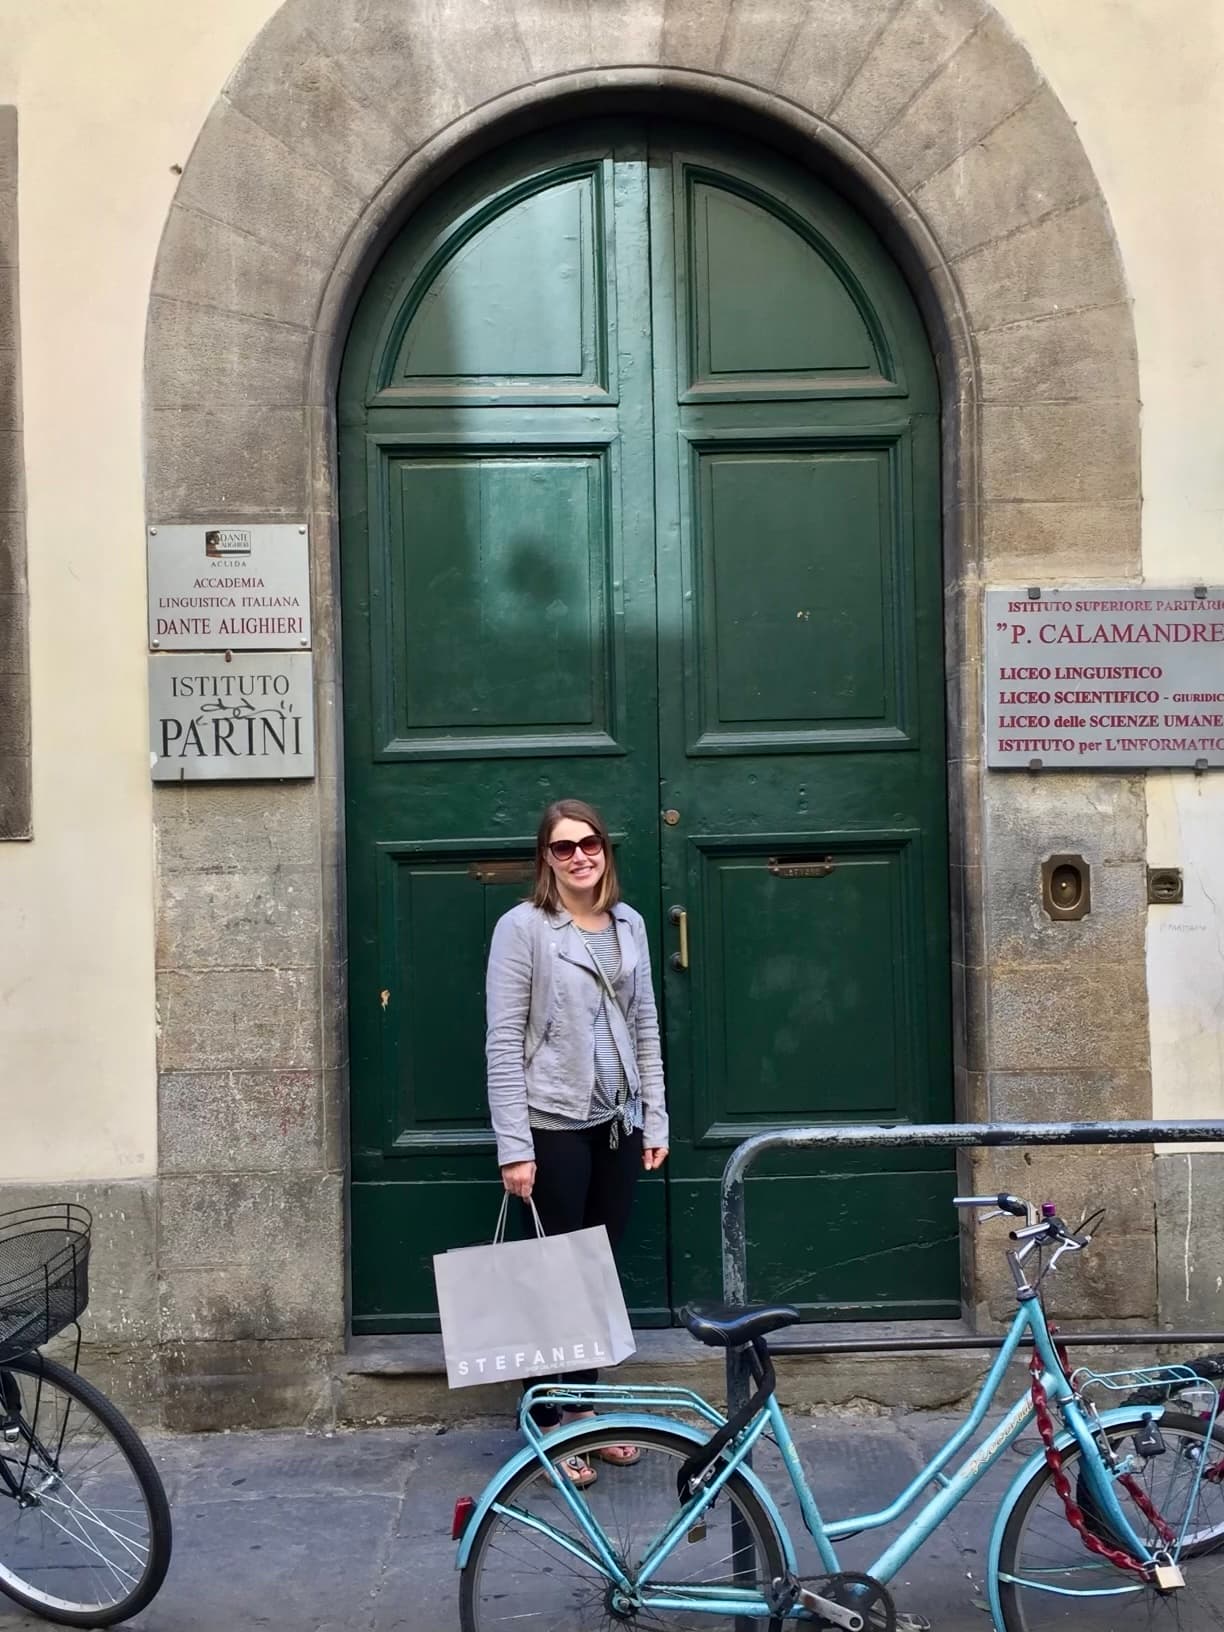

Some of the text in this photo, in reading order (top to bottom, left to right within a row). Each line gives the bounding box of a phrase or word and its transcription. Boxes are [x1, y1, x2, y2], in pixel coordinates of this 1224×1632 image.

[193, 578, 264, 588] ACCADEMIA
[159, 596, 300, 608] LINGUISTICA ITALIANA
[1008, 601, 1072, 612] ISTITUTO
[1075, 601, 1152, 612] SUPERIORE
[157, 617, 303, 635] DANTE ALIGHIERI
[1000, 666, 1162, 680] LICEO LINGUISTICO
[171, 675, 289, 697] ISTITUTO
[999, 691, 1051, 704] LICEO
[1054, 690, 1159, 704] SCIENTIFICO
[999, 714, 1224, 728] LICEO delle SCIENZE UMANE
[160, 717, 302, 757] PARINI
[998, 739, 1075, 752] ISTITUTO
[1079, 741, 1102, 754] per
[458, 1341, 605, 1376] STEFANEL
